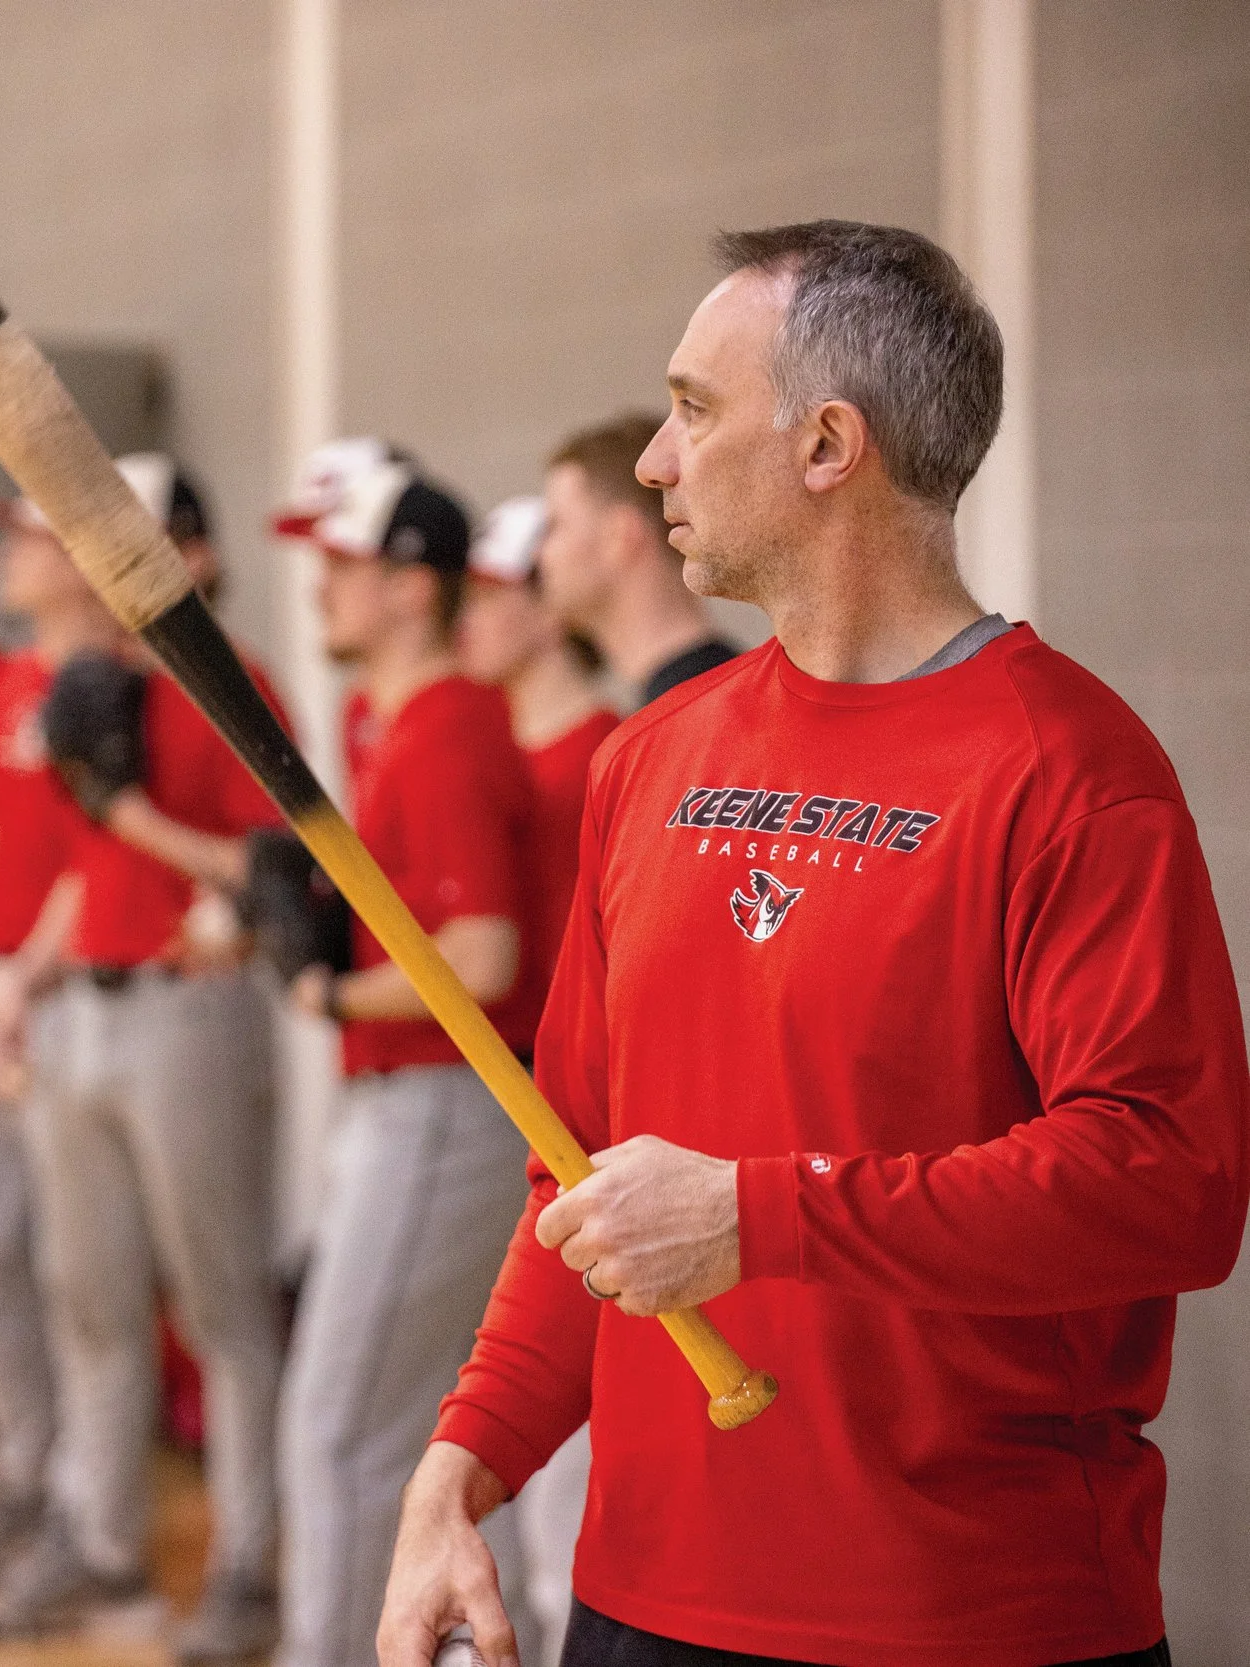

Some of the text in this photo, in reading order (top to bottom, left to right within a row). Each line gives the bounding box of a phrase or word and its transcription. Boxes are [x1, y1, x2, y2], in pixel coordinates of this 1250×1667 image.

[666, 786, 941, 853] KEENE STATE
[697, 838, 864, 872] BASEBALL
